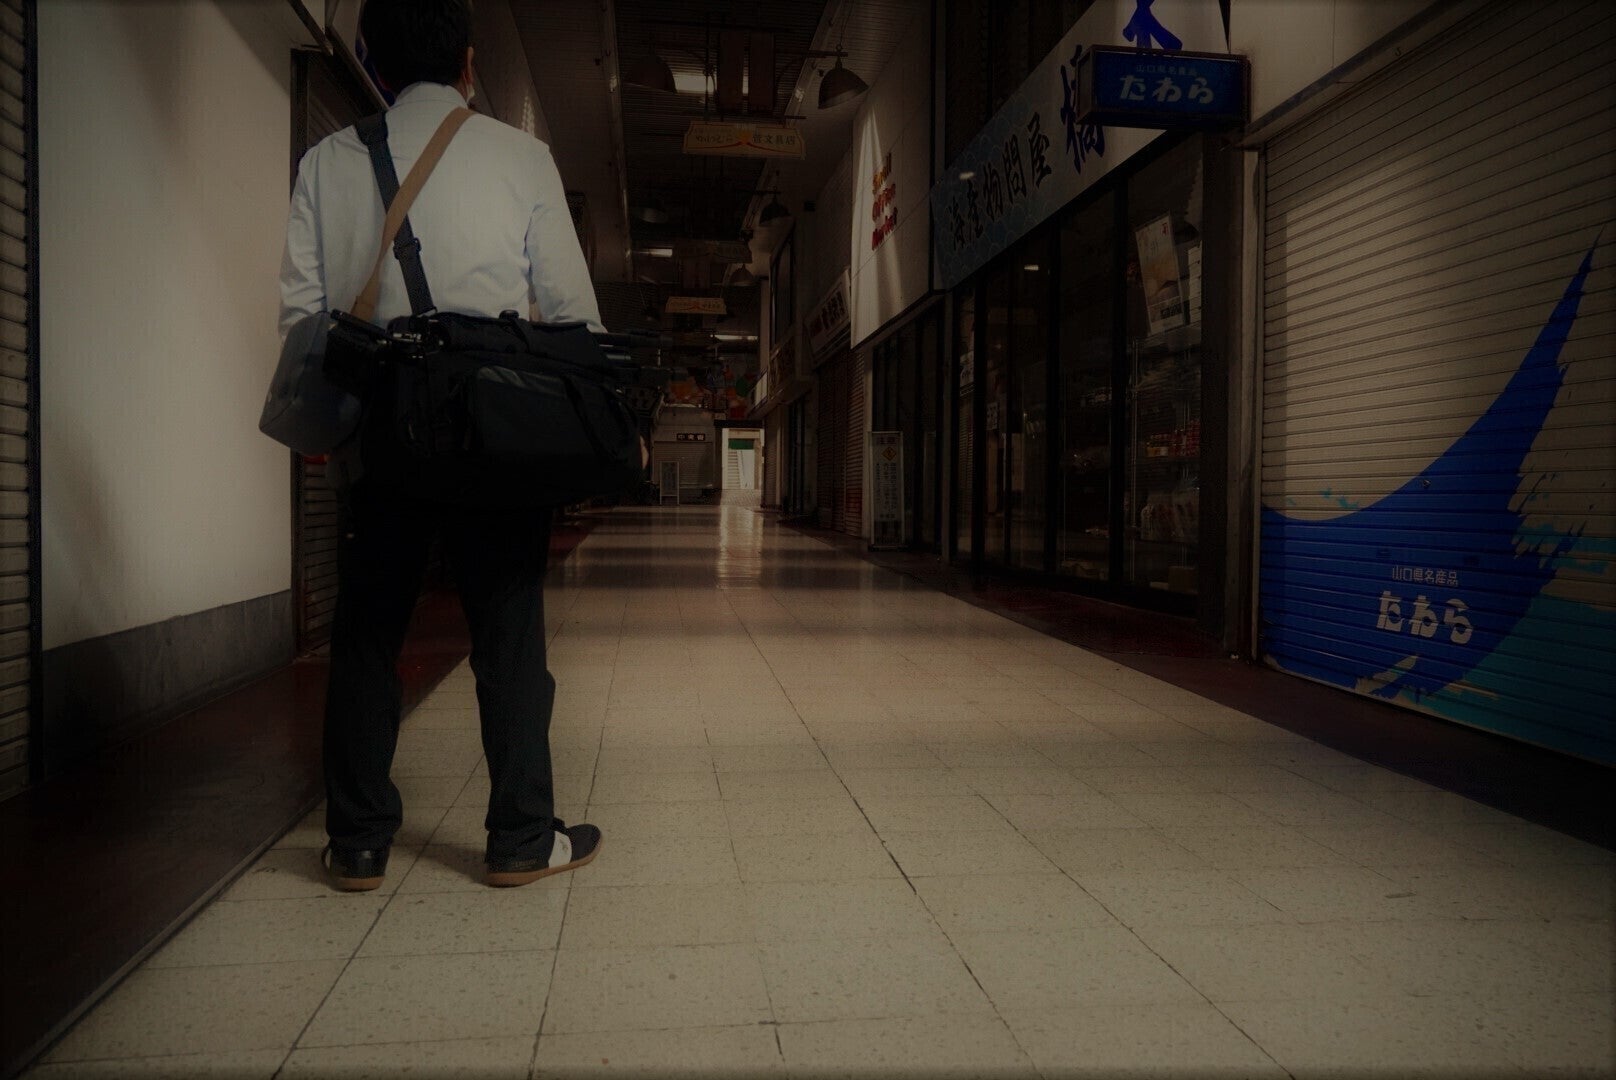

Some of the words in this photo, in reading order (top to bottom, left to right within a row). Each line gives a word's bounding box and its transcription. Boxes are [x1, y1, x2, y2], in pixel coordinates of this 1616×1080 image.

[1118, 74, 1216, 105] たわら
[1391, 564, 1459, 588] 山口県名産品
[1375, 589, 1475, 646] たわら
